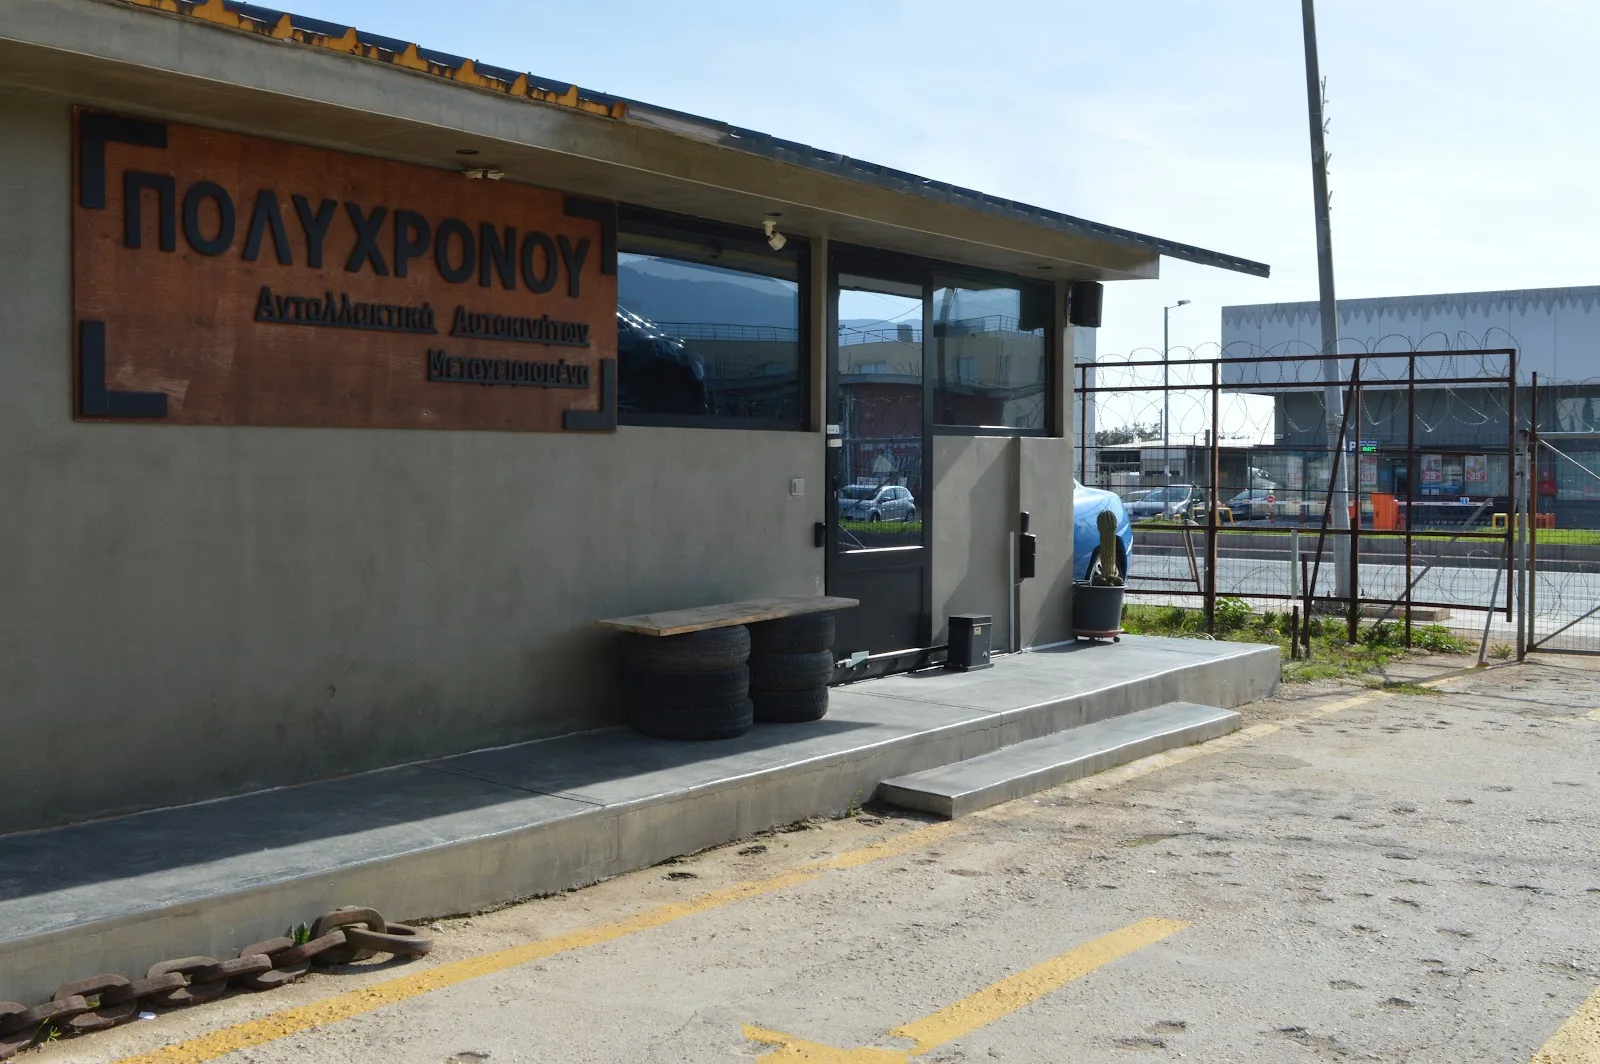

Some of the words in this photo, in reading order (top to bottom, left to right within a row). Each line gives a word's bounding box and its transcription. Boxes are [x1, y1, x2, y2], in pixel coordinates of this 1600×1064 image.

[123, 168, 590, 297] ΠΟΛΥΧΡΟΝΟΥ
[254, 286, 437, 334] Ανταλλακτικά
[449, 304, 590, 347] Αυτοκινήτων
[427, 348, 589, 389] Μεταχειρισμένα
[1349, 441, 1356, 451] P
